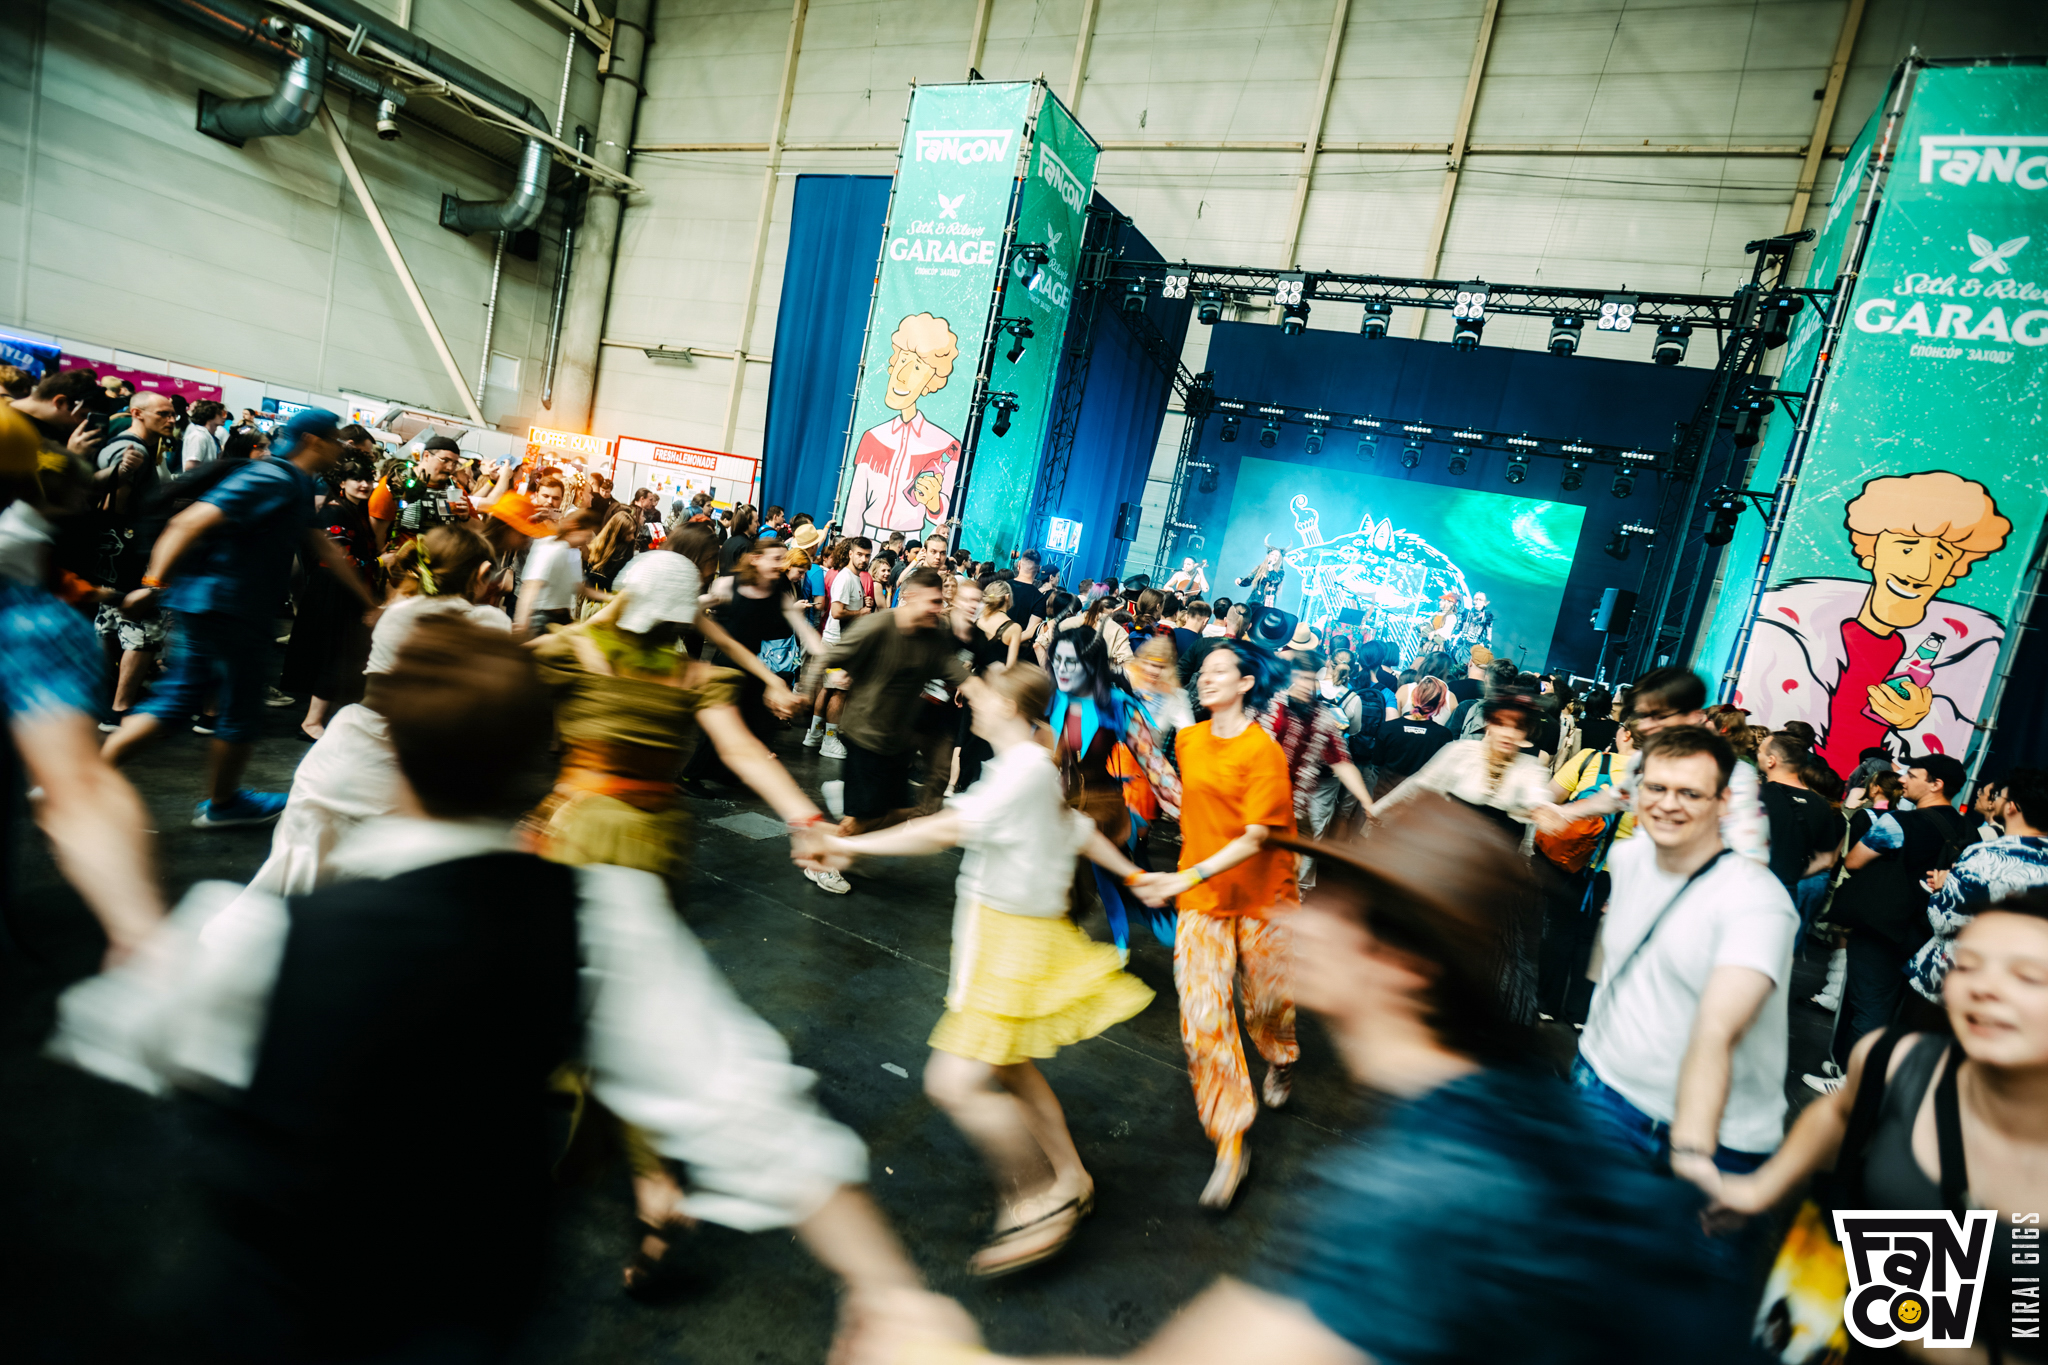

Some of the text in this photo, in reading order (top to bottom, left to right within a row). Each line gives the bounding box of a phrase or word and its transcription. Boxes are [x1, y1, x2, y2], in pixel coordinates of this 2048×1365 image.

[1919, 135, 2048, 190] FaNC
[906, 220, 985, 238] Seth & Riley's
[890, 237, 996, 268] GARAGE
[1014, 253, 1071, 310] GRAGE
[1893, 272, 1957, 297] Seth
[1958, 278, 1984, 297] &
[1909, 344, 2015, 364] СПОНСОР ЗАХОДУ
[532, 429, 568, 448] COFFEE
